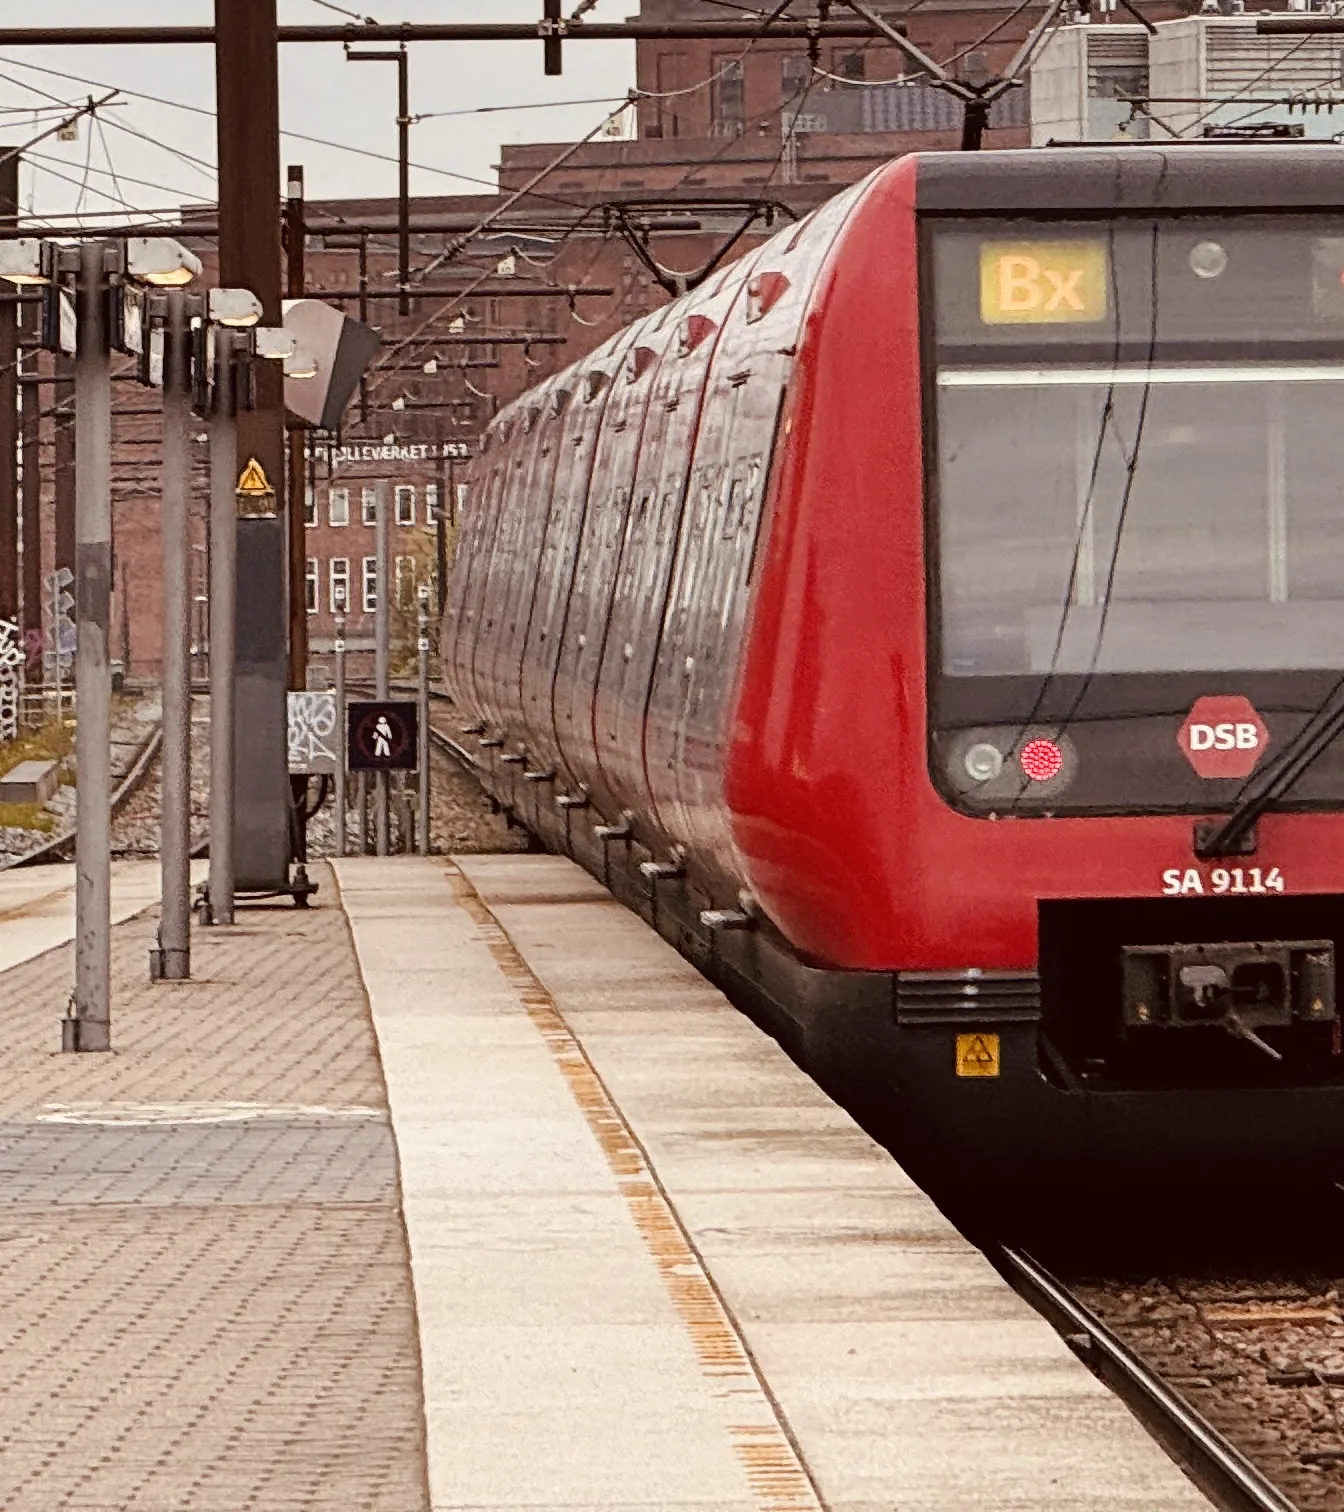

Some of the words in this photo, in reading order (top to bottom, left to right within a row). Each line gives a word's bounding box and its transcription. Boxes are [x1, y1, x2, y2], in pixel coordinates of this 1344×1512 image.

[998, 256, 1085, 311] Bx
[1189, 723, 1259, 751] DSB
[1162, 868, 1204, 895] SA
[1211, 867, 1284, 893] 9114
